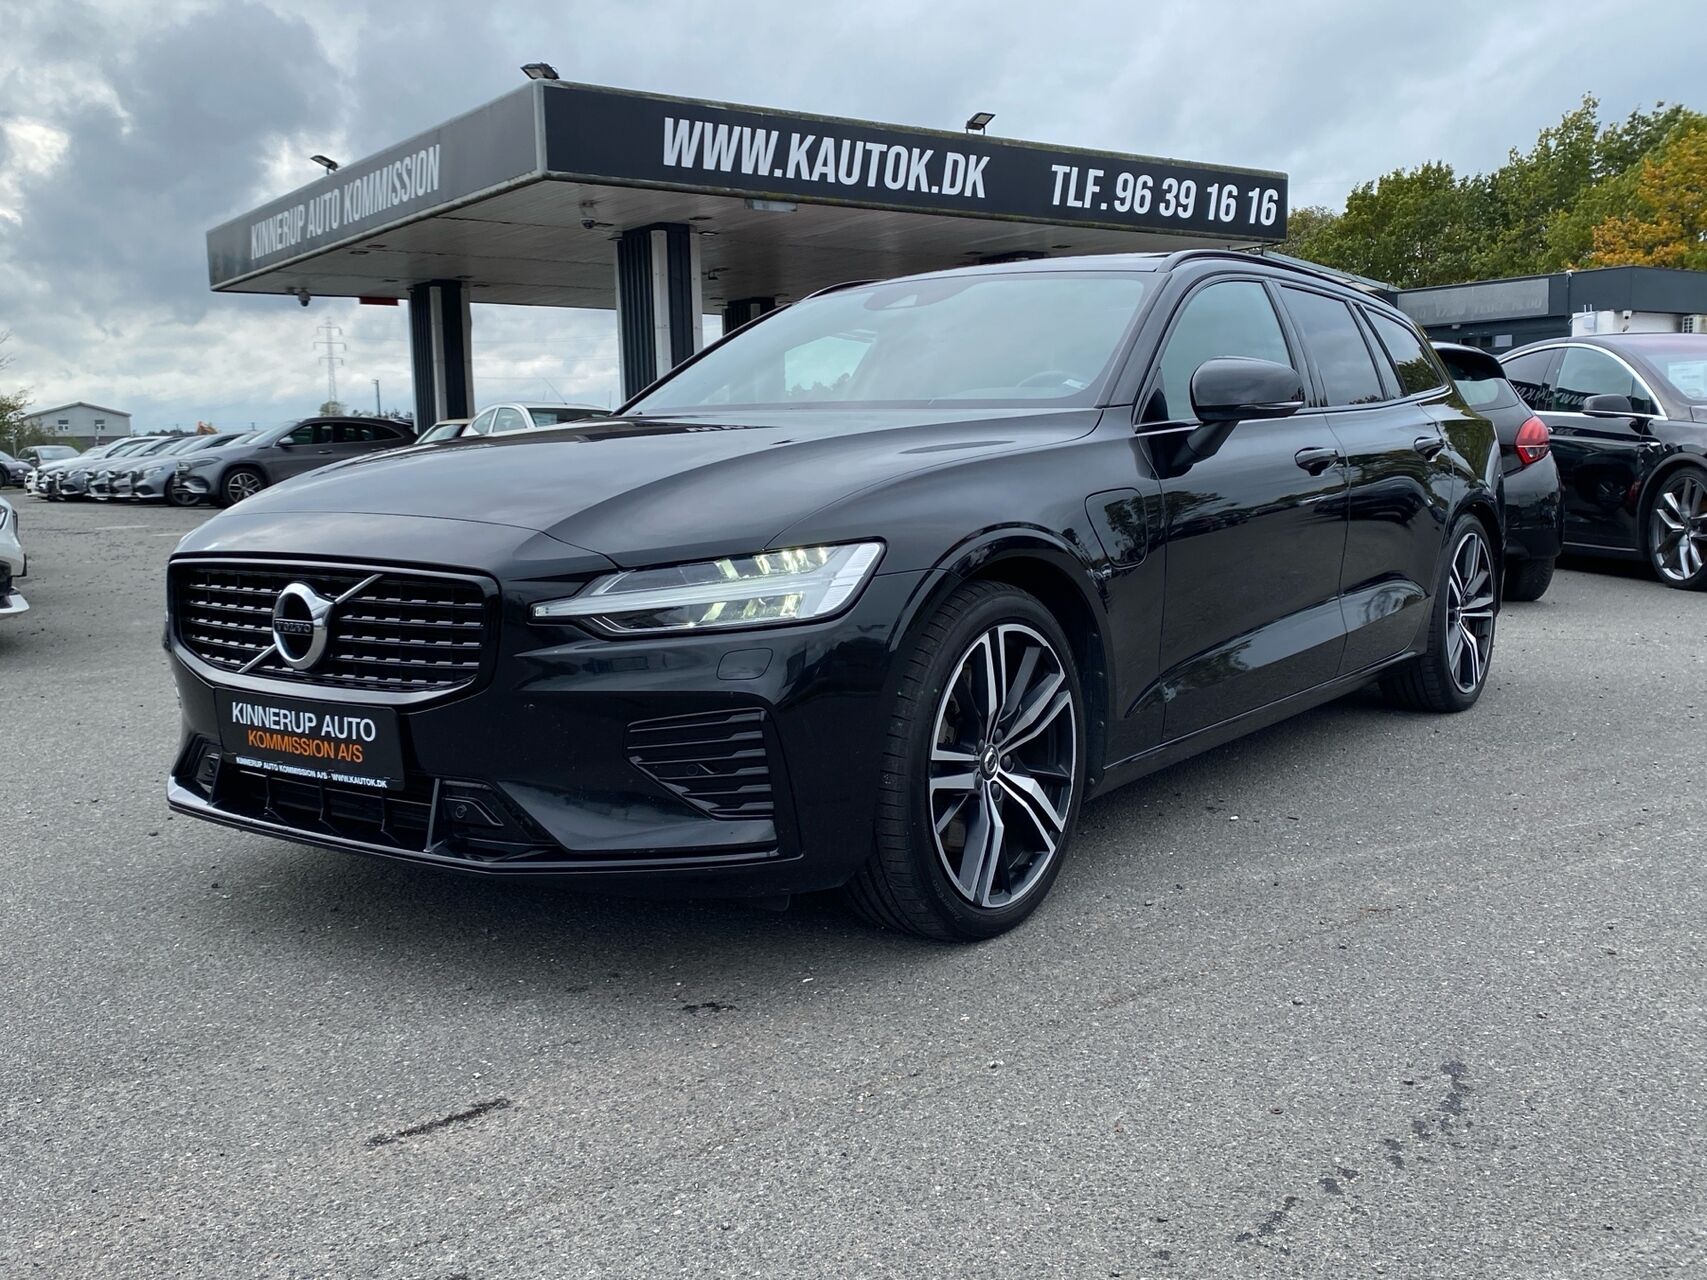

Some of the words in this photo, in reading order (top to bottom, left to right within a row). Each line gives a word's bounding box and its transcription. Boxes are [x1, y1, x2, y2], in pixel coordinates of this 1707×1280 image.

[662, 117, 990, 198] WWW.KAUTOK.DK
[251, 204, 305, 260] KINNERUP
[306, 188, 341, 240] AUTO
[343, 144, 441, 225] KOMMISSION
[1051, 164, 1108, 211] TLF.
[1113, 172, 1154, 215] 96
[1159, 177, 1198, 220] 39
[1206, 183, 1239, 223] 16
[1248, 187, 1279, 227] 16
[231, 701, 317, 735] KINNERUP
[320, 714, 376, 742] AUTO
[247, 730, 335, 760] KOMMISSION
[337, 742, 364, 763] A/S
[235, 756, 263, 769] KINNERUP
[263, 761, 279, 772] AUTO
[279, 761, 317, 778] KOMMISSION
